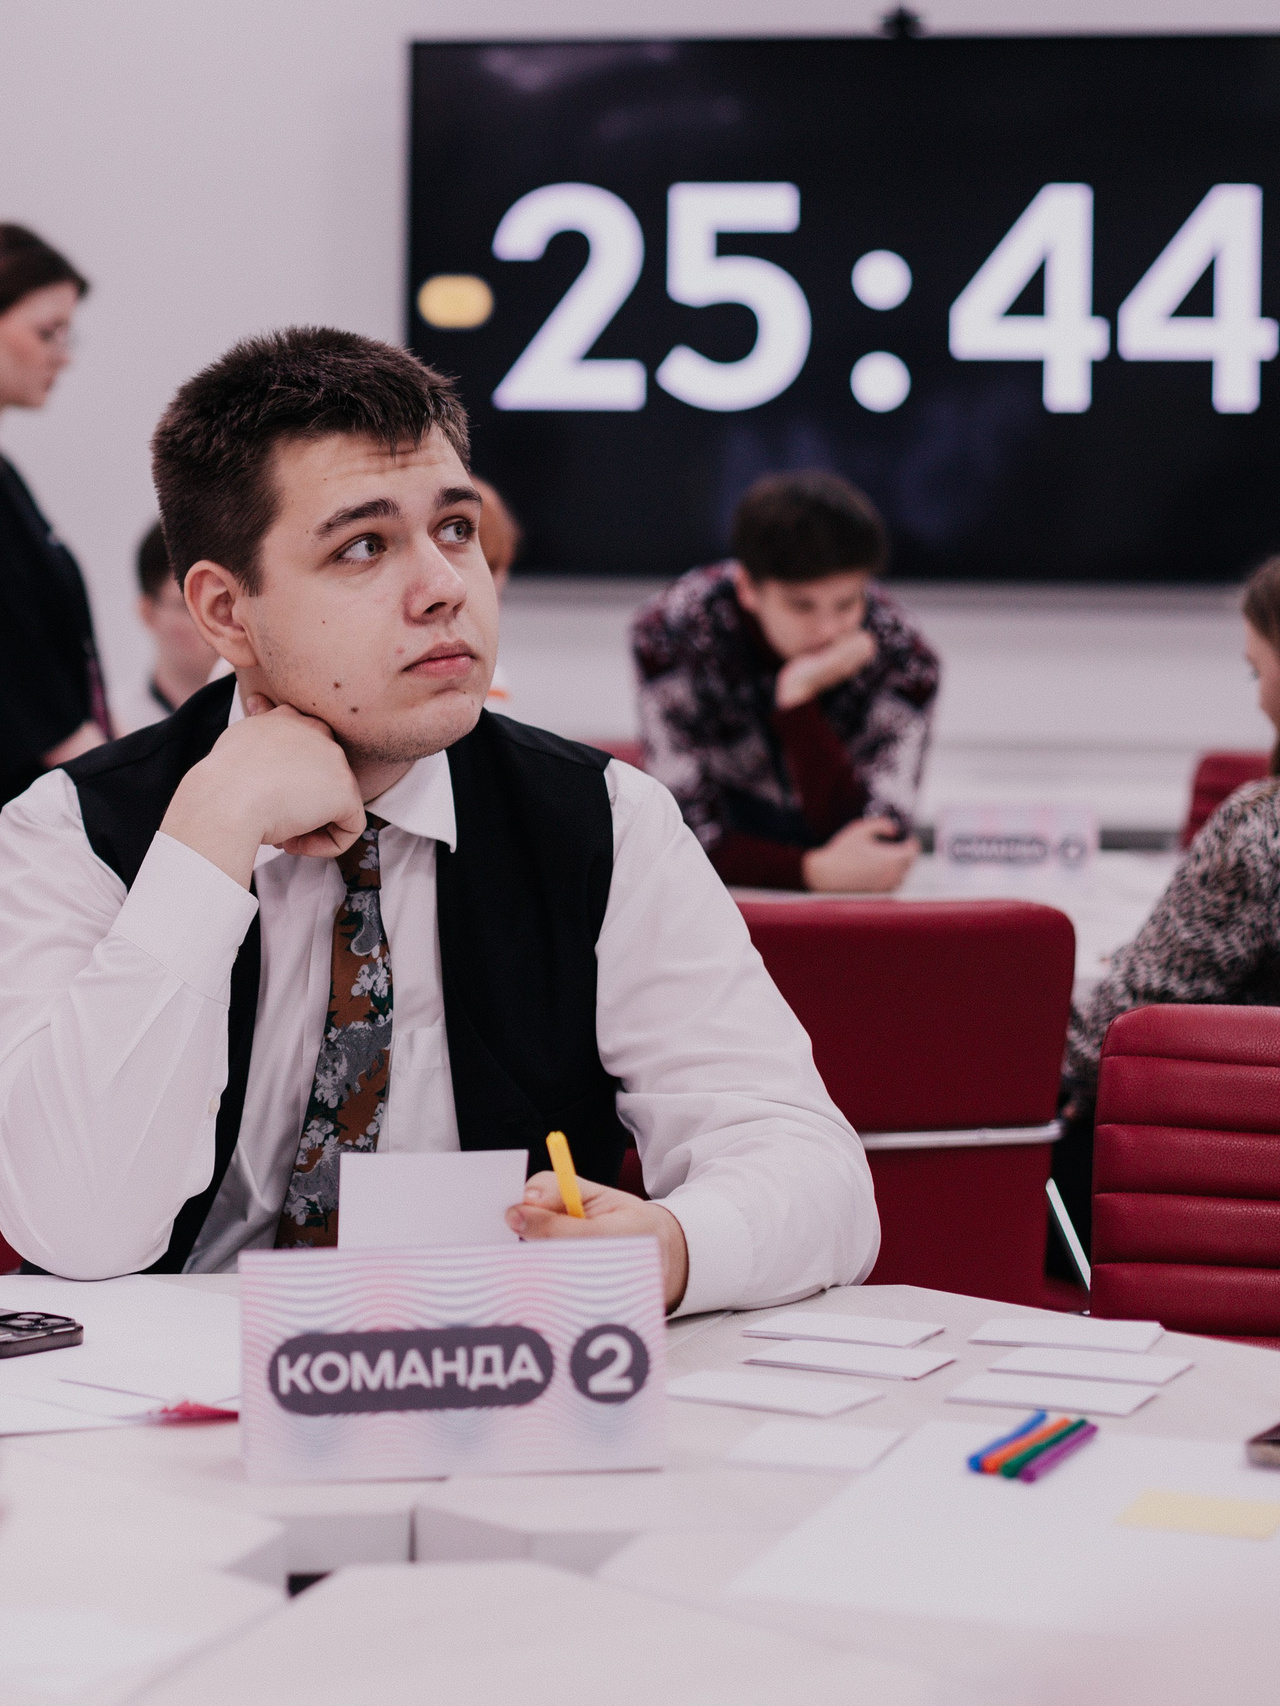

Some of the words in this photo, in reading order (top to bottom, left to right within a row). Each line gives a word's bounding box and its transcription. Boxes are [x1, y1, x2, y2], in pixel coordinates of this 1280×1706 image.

[493, 182, 1279, 413] 25:44
[277, 1343, 544, 1395] КОМАНДА
[585, 1333, 634, 1394] 2
